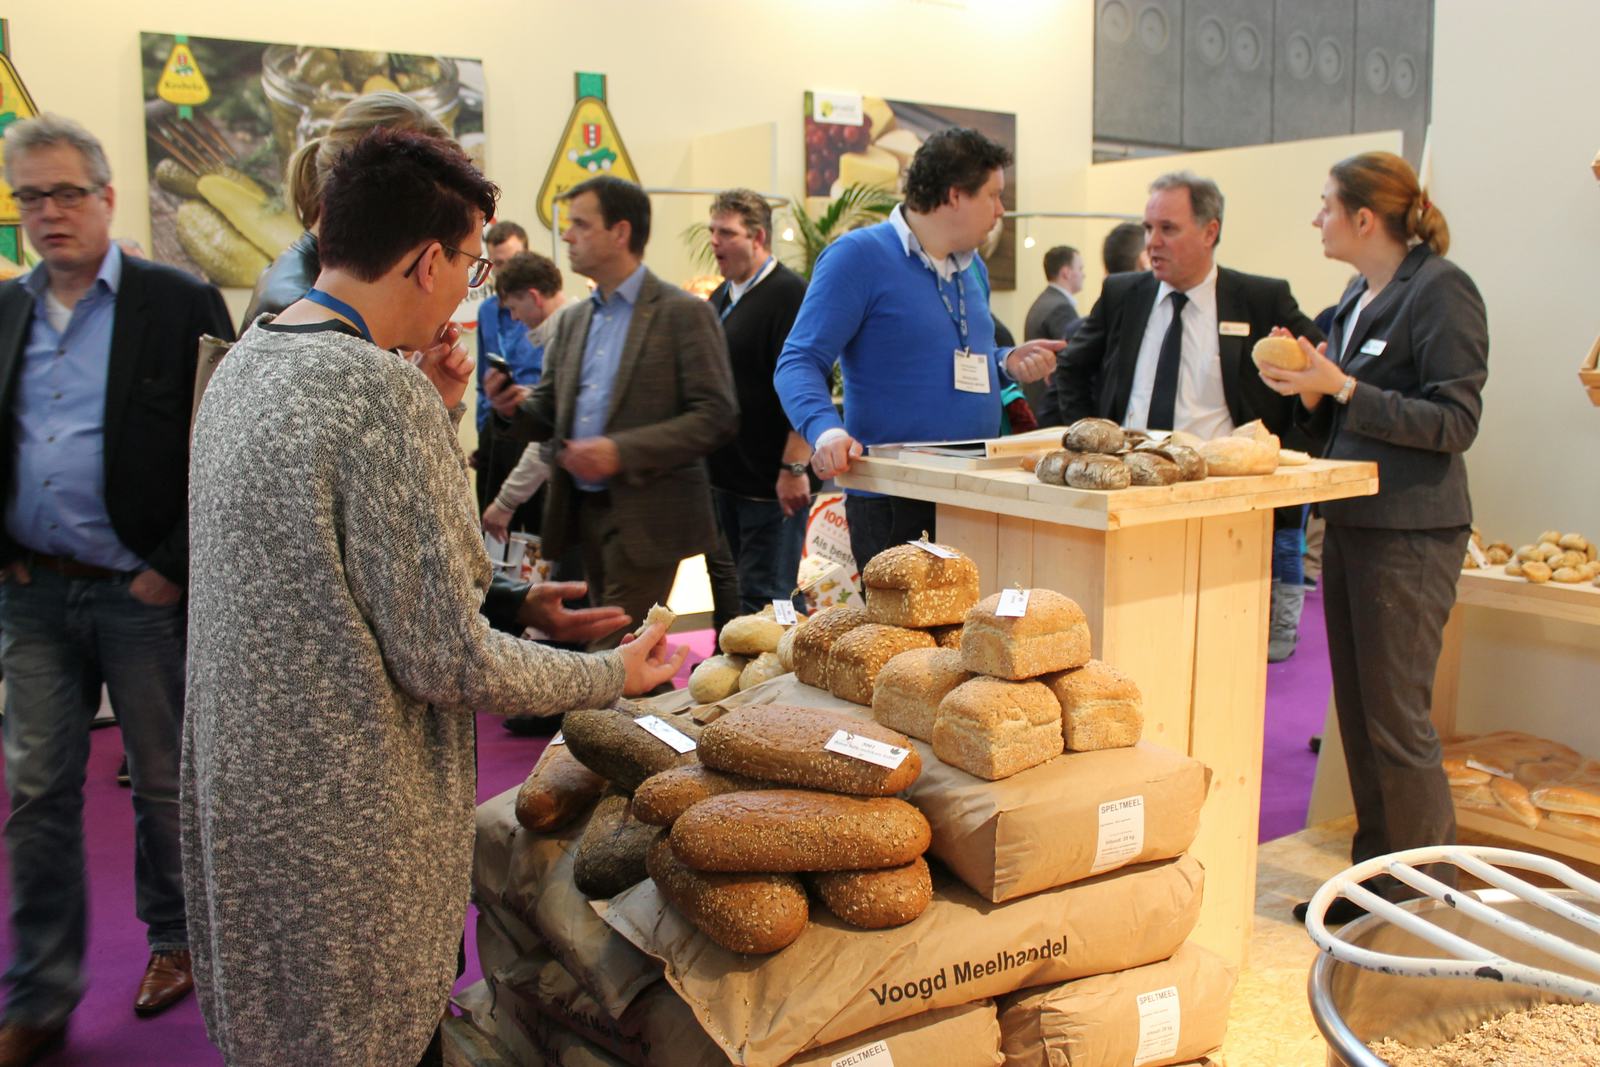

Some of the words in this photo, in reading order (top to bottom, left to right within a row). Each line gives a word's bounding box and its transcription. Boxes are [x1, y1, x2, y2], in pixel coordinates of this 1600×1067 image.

[813, 536, 827, 551] Als
[1101, 798, 1142, 814] SPELTMEEL
[869, 968, 947, 1006] Voogd
[953, 935, 1068, 985] Meelhandel
[1139, 989, 1176, 1005] SPELTMEEL
[835, 1044, 886, 1067] SPELTMEEL
